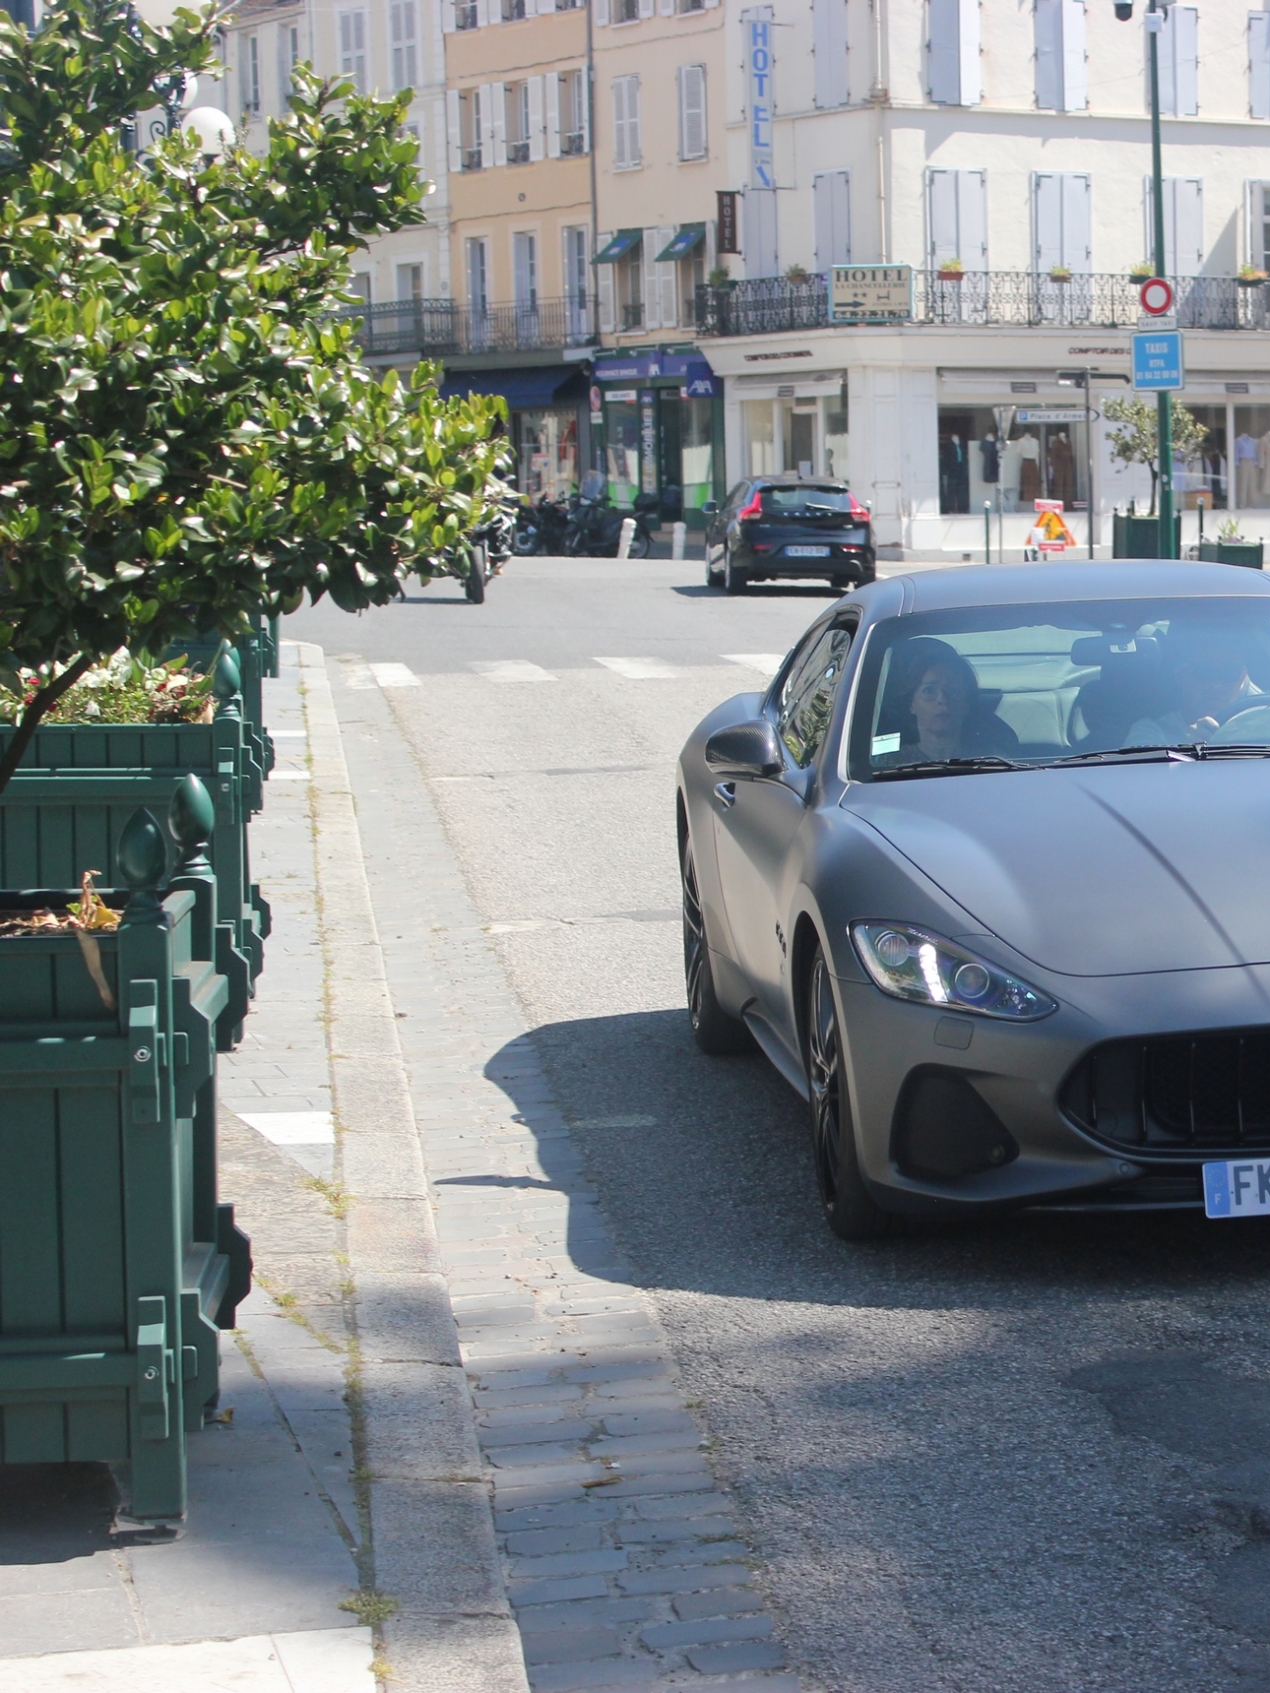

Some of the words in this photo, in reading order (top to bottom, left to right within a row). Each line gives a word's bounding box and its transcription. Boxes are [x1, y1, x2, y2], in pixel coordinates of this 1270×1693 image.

[752, 23, 769, 147] HOTEL
[723, 196, 732, 248] HOTEL
[835, 269, 907, 282] HOTEL
[1145, 342, 1169, 354] TAXIS
[688, 380, 713, 394] AXA
[1030, 412, 1051, 420] Place
[1214, 1194, 1221, 1205] F
